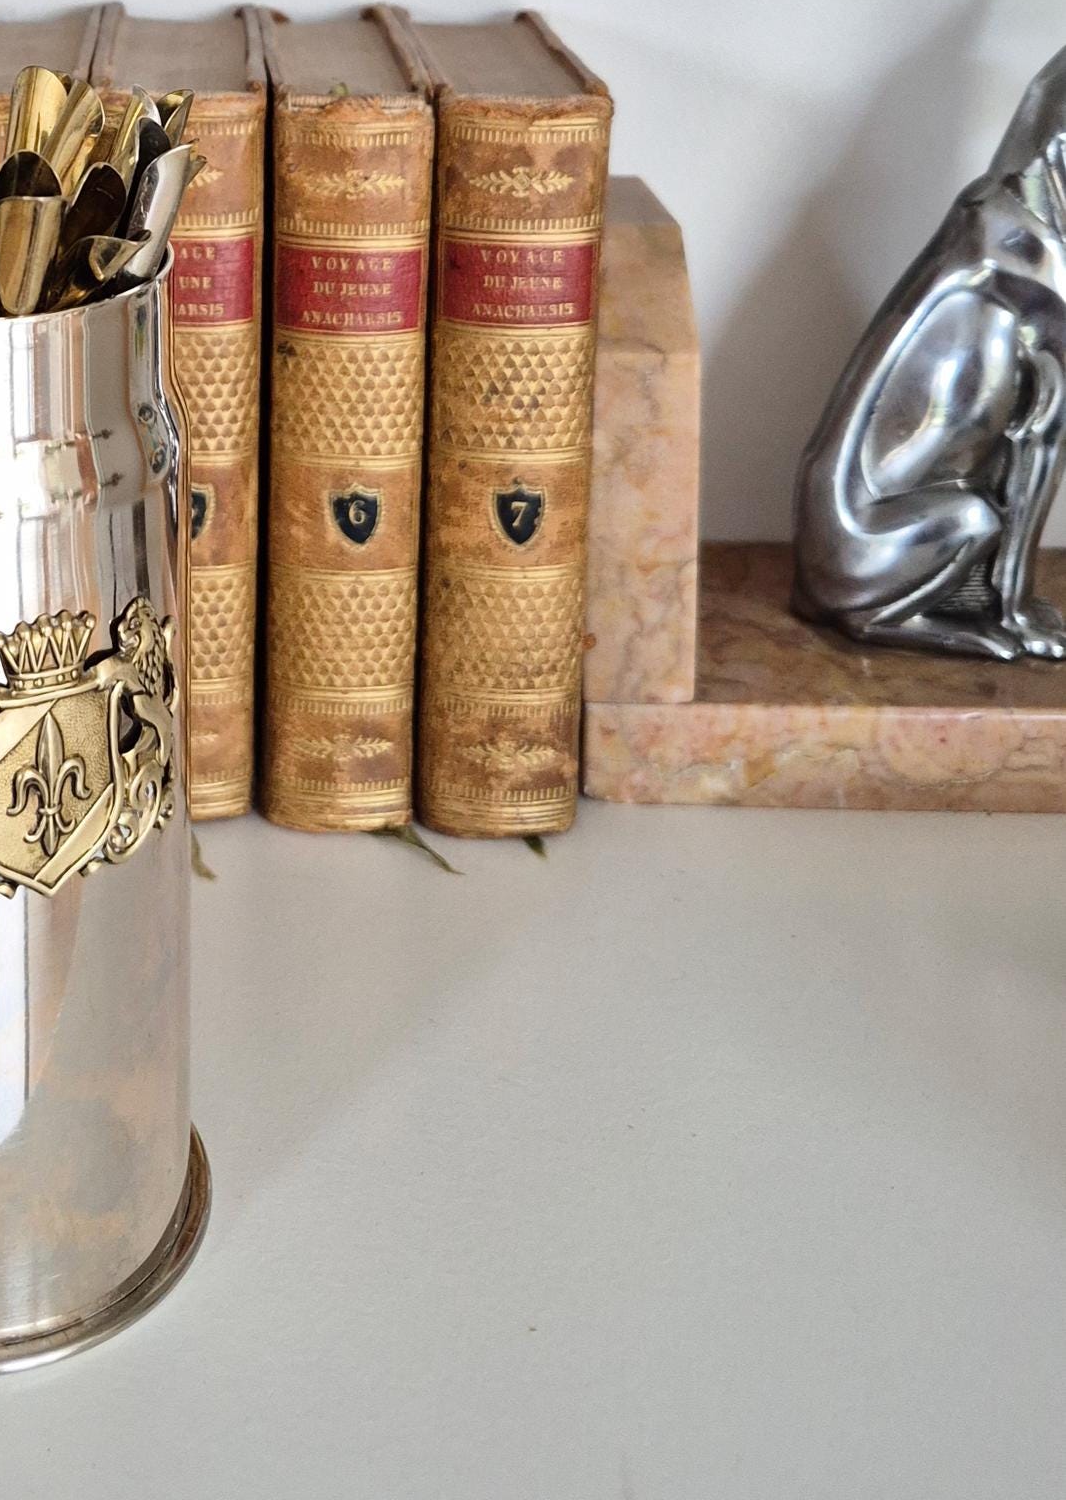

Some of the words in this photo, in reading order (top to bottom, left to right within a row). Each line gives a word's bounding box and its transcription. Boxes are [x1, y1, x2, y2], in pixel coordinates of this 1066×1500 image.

[180, 246, 215, 259] AGE
[481, 250, 564, 263] VOYAGE
[312, 256, 393, 271] VOYAGE
[313, 281, 335, 295] DU
[340, 282, 392, 296] JEUNE
[484, 275, 505, 288] DU
[511, 276, 563, 290] JEUNE
[472, 303, 574, 318] ANACHARSIS
[302, 310, 402, 327] ANACHARSIS
[349, 500, 365, 524] 6
[511, 501, 526, 528] 7
